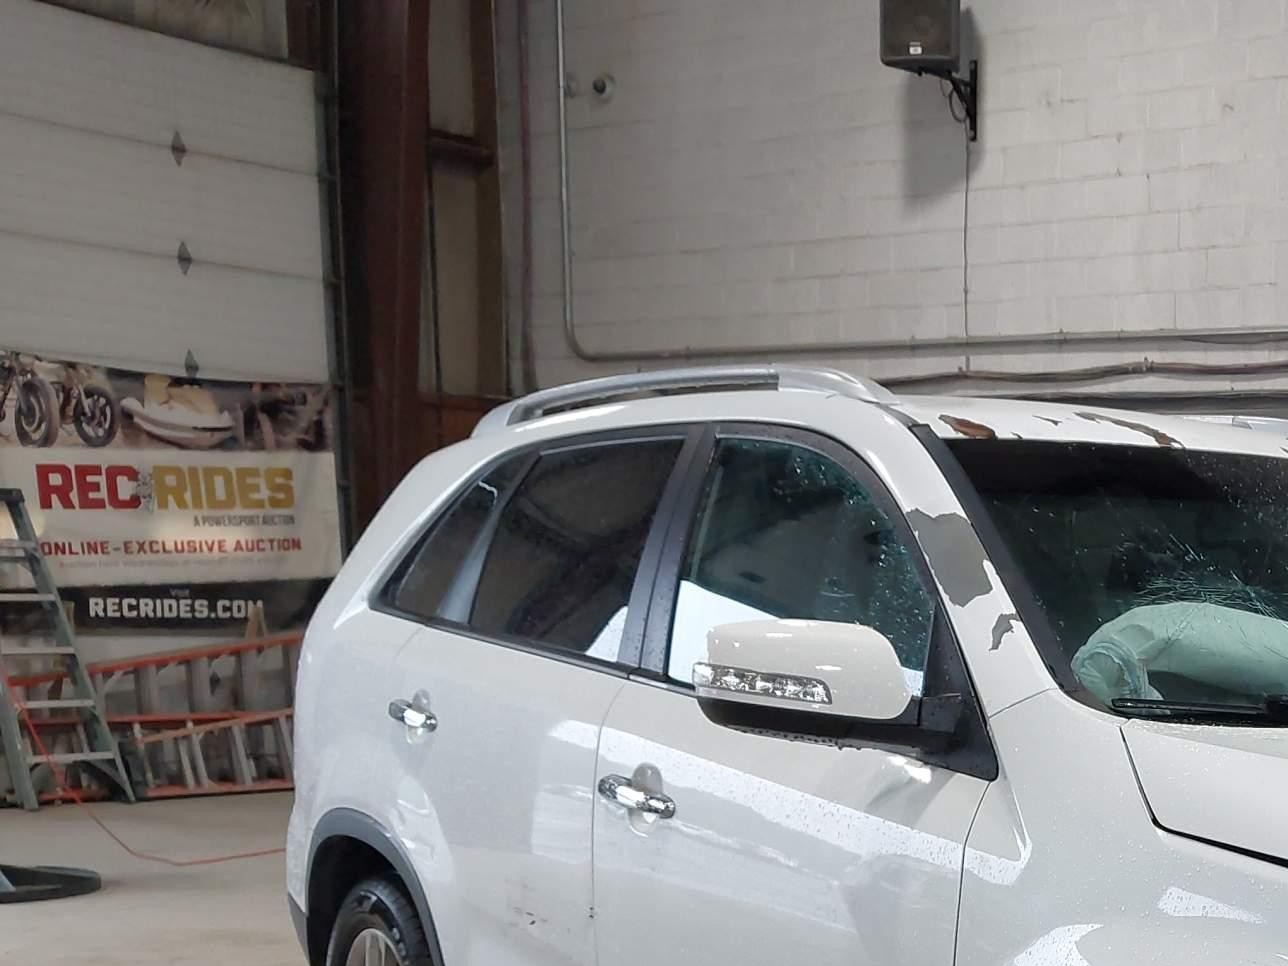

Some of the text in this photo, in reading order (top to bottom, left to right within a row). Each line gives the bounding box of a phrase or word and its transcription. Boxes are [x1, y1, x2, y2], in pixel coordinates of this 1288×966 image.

[35, 464, 295, 510] REC RIDES
[261, 515, 296, 526] AUCTION
[41, 537, 302, 556] ONLINE-EXCLUSIVE AUCTION
